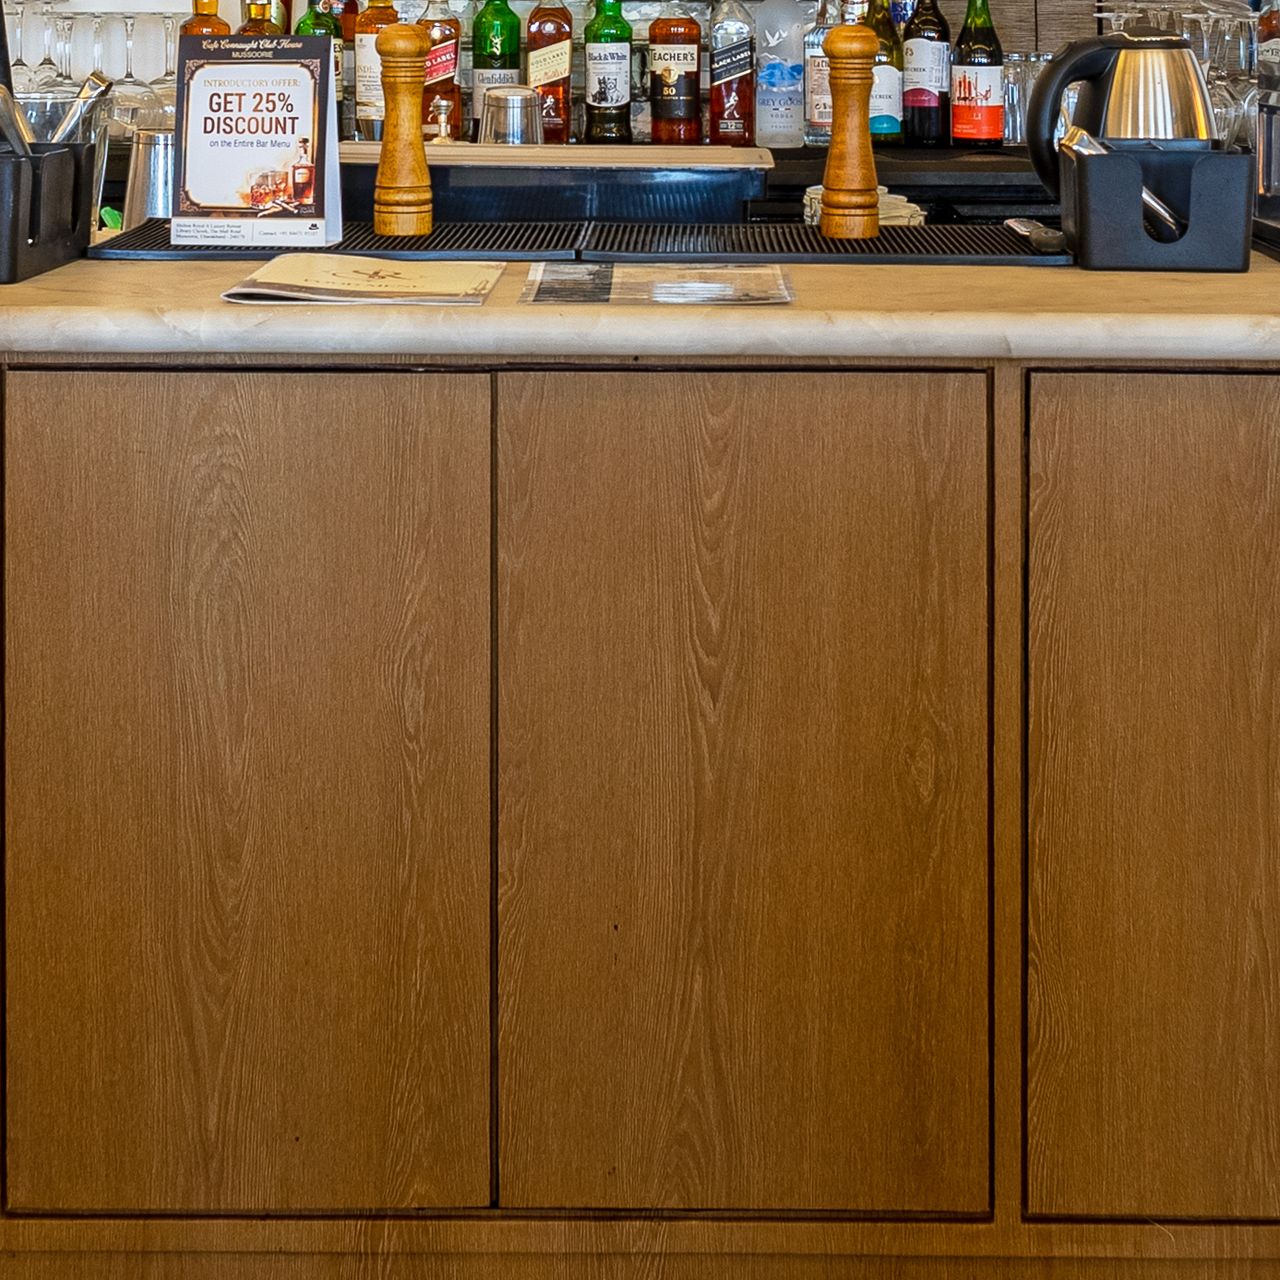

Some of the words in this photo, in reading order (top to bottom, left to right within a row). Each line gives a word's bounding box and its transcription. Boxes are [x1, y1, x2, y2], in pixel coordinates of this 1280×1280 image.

[202, 39, 219, 51] Cafe
[220, 39, 258, 51] Connaught
[259, 39, 278, 49] Club
[278, 38, 303, 49] House
[432, 52, 455, 63] LABEL
[649, 48, 696, 66] TEACHER'S
[204, 79, 269, 88] INTRODUCTORY
[477, 72, 515, 84] Glenfiddich
[208, 92, 246, 113] GET
[252, 92, 295, 113] 25%
[203, 116, 300, 135] DISCOUNT
[221, 139, 232, 148] the
[234, 140, 254, 148] Entire
[256, 140, 269, 148] Bar
[271, 140, 291, 148] Menu
